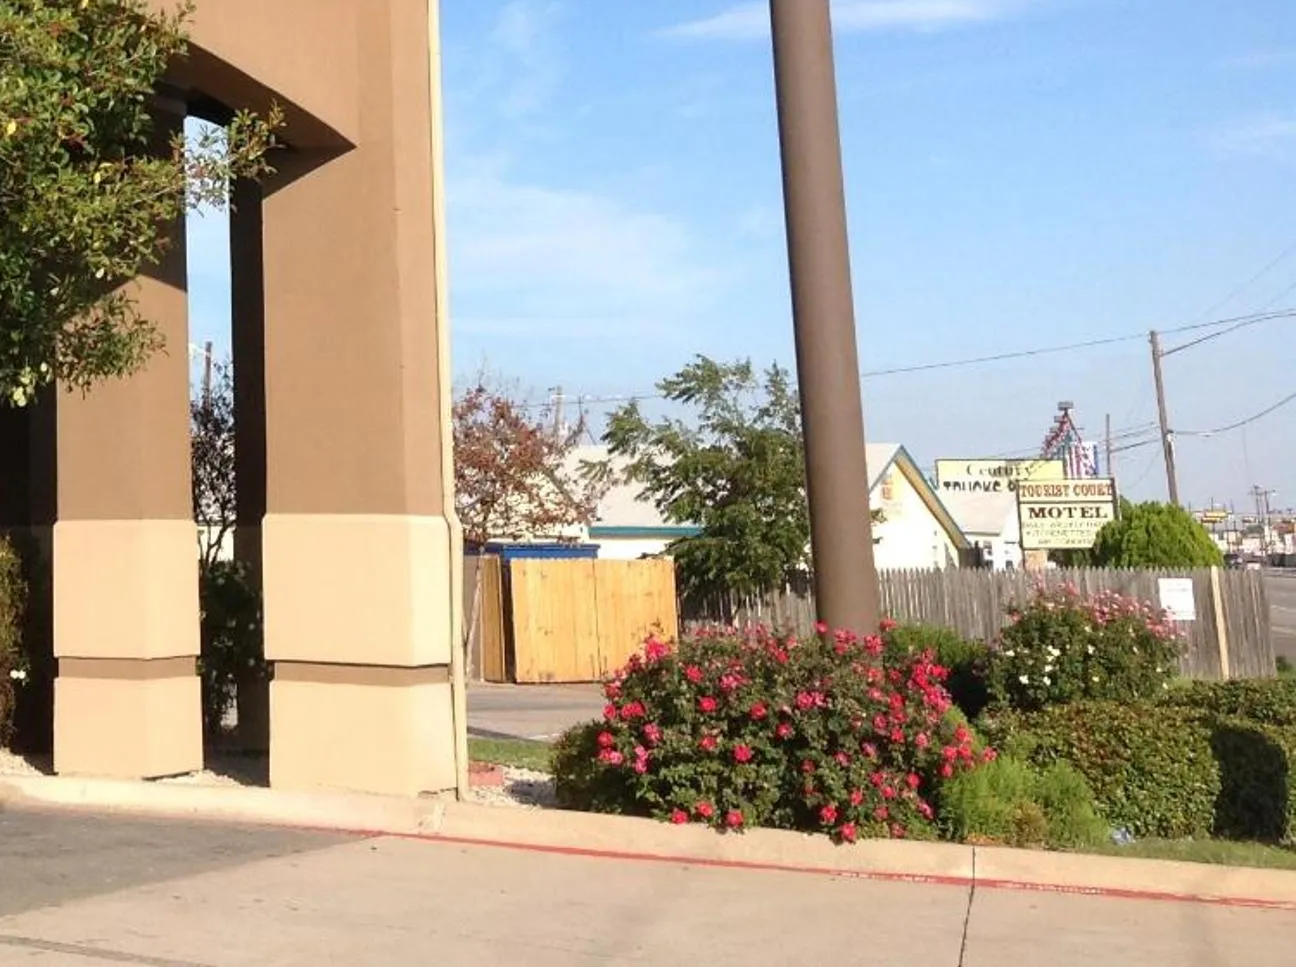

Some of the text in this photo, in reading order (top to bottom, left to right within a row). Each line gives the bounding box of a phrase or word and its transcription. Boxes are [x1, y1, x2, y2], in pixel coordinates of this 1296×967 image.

[1021, 484, 1071, 498] TOURIST
[1073, 483, 1113, 497] COURT
[1027, 506, 1108, 519] MOTEL
